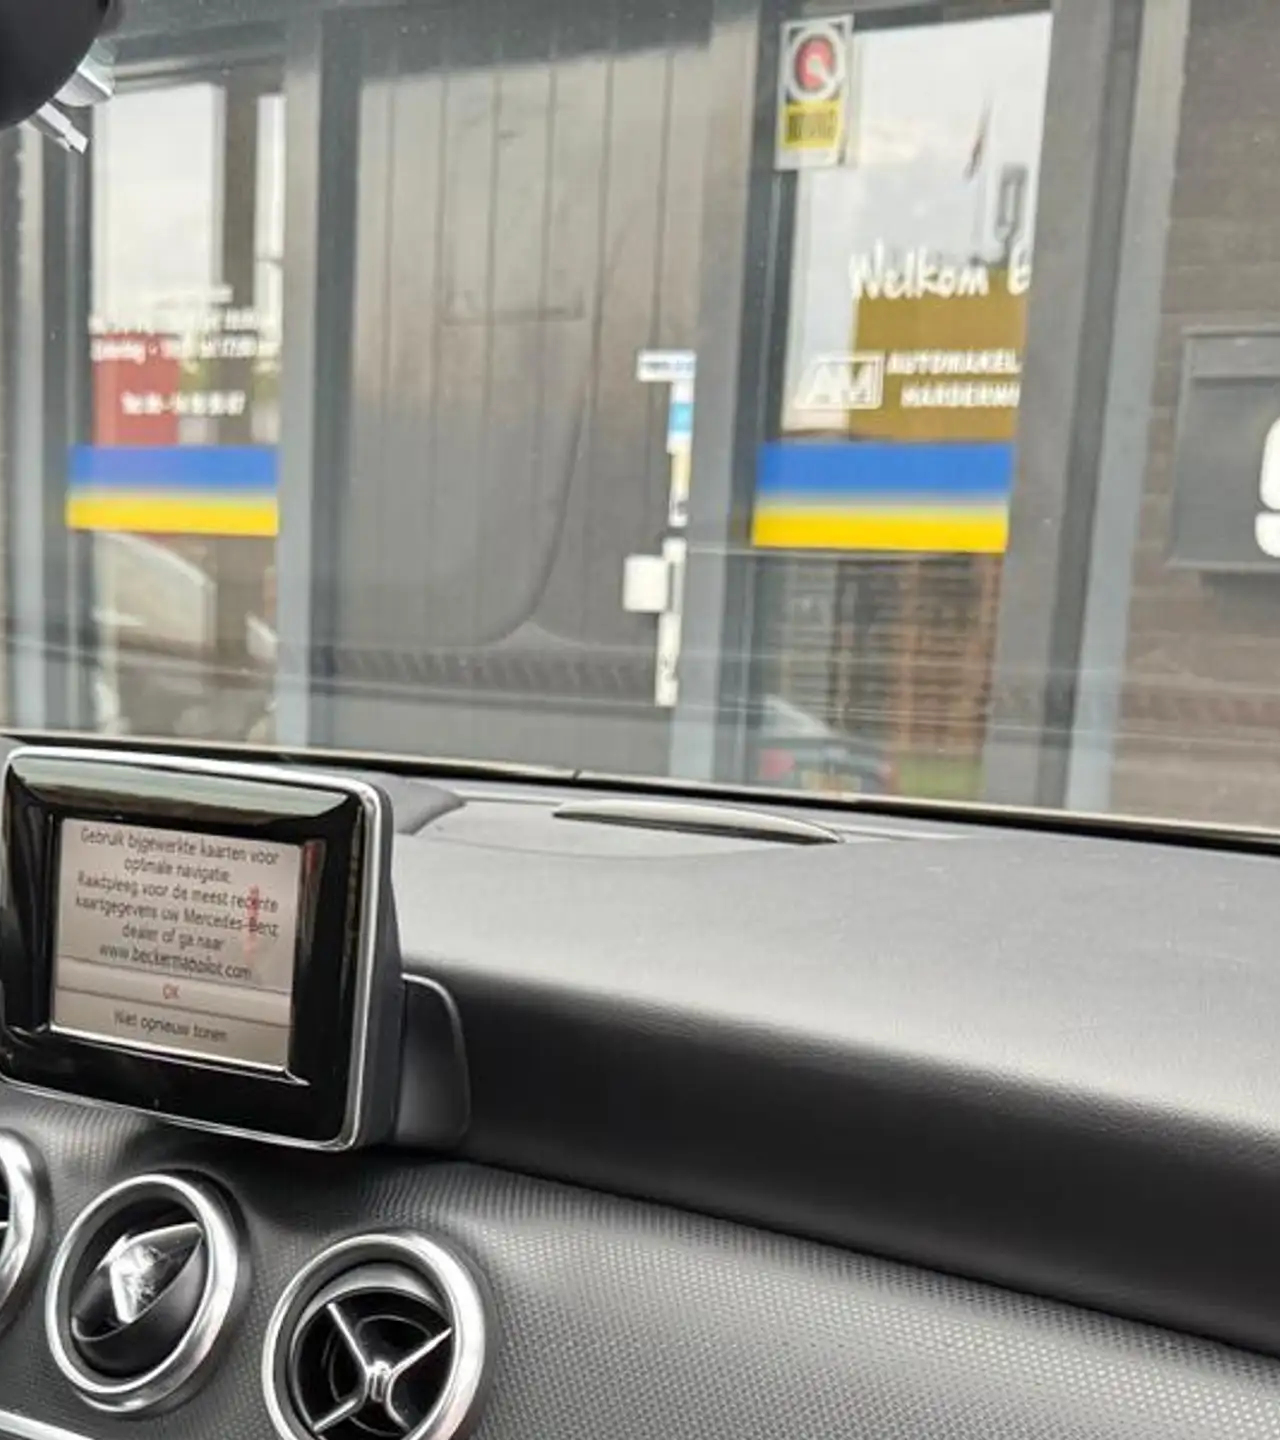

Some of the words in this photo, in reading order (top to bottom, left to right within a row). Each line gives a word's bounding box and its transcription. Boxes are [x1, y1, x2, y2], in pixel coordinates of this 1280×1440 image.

[849, 239, 990, 302] Welkom
[81, 827, 124, 846] Gebruik
[200, 838, 247, 860] kaarten
[250, 849, 279, 866] voor
[143, 883, 169, 897] voor
[172, 883, 188, 900] de
[192, 888, 227, 906] meest
[162, 927, 176, 943] of
[197, 935, 225, 951] naar
[163, 984, 180, 1000] OK
[141, 1016, 189, 1035] opnieuw
